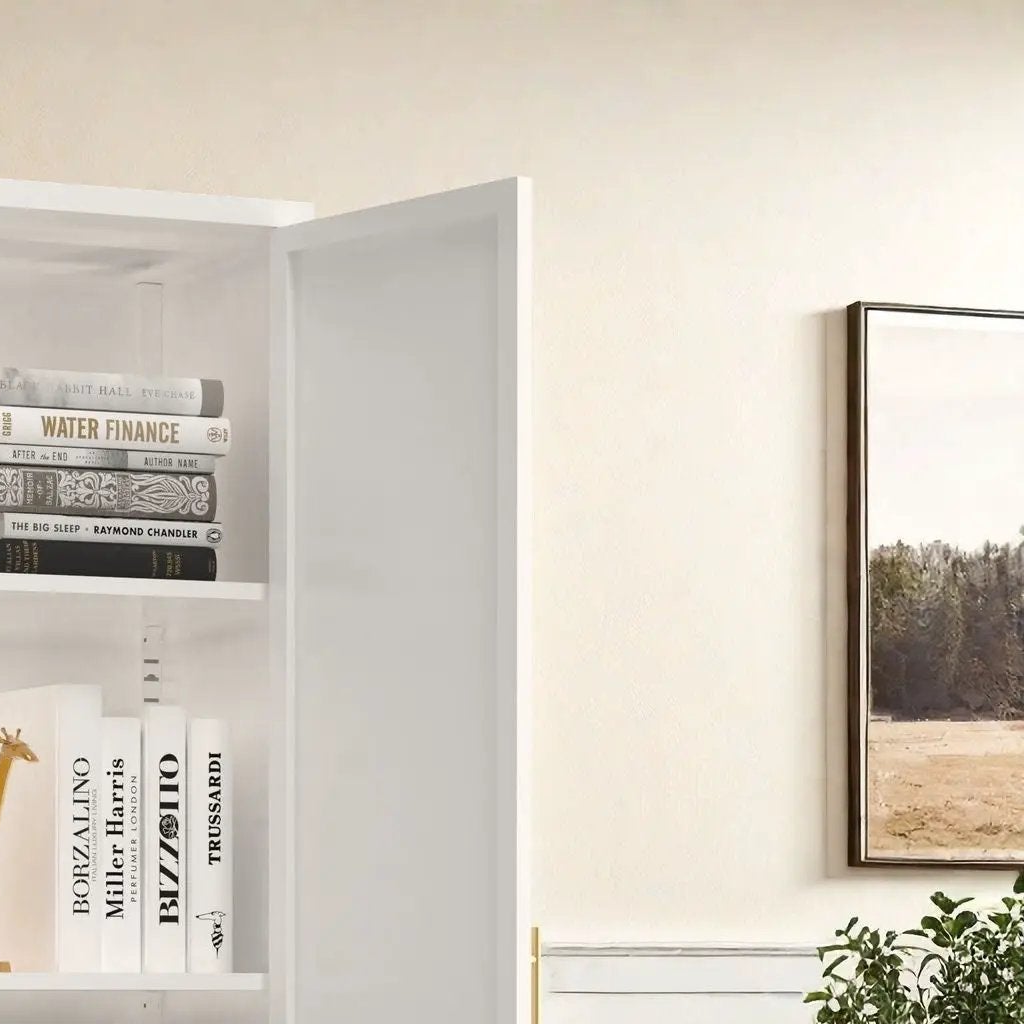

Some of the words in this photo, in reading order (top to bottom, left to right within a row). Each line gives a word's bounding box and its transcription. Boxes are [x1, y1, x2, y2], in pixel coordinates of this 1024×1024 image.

[99, 385, 132, 397] HALL
[141, 388, 161, 398] EVE
[2, 411, 12, 437] GRIGG
[41, 415, 99, 440] WATER
[105, 419, 180, 444] FINANCE
[12, 449, 36, 460] AFTER
[52, 451, 68, 462] END
[144, 456, 173, 467] AUTHOR
[177, 459, 199, 469] NAME
[11, 521, 29, 531] THE
[32, 523, 50, 532] BIG
[53, 523, 81, 533] SLEEP
[93, 525, 144, 536] RAYMOND
[147, 527, 198, 539] CHANDLER
[106, 758, 125, 838] Harris
[130, 775, 138, 831] LONDON
[208, 752, 222, 866] TRUSSARDI
[73, 757, 90, 916] BORZALINO
[106, 844, 125, 920] Miller
[130, 839, 138, 903] PERFUMER
